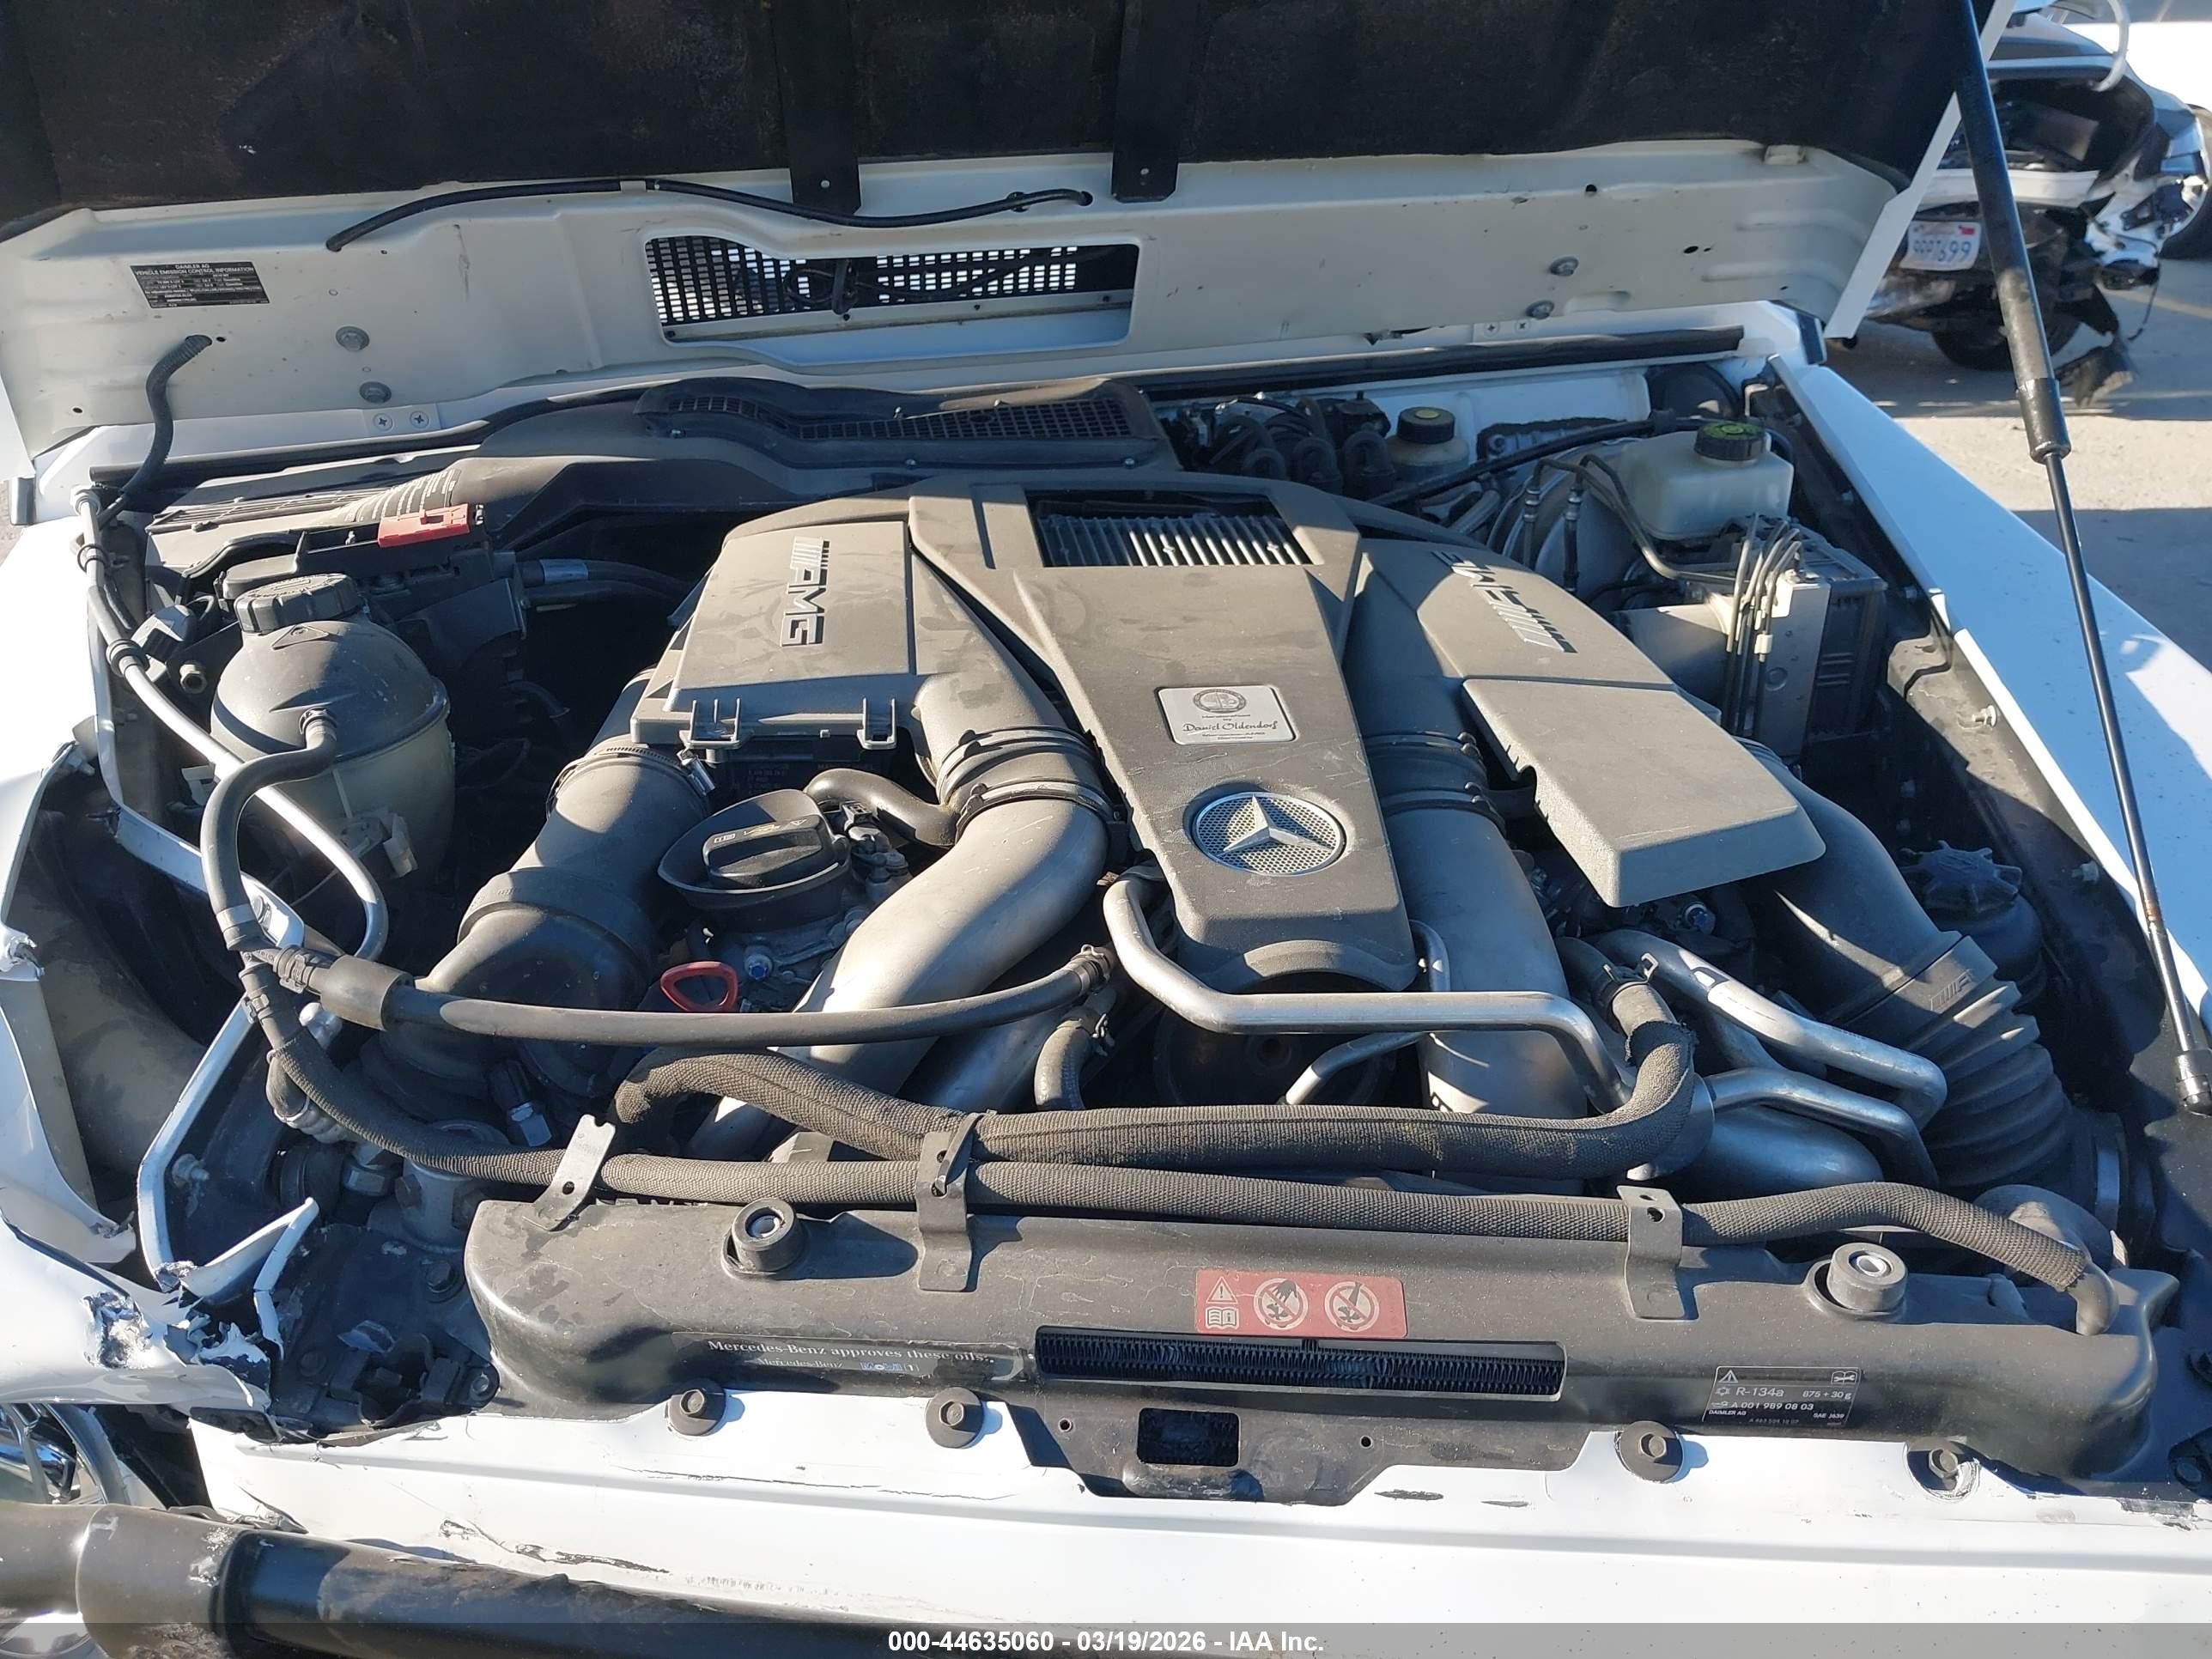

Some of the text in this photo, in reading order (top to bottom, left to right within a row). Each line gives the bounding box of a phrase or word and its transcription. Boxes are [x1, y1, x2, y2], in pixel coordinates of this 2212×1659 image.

[780, 566, 830, 647] AMG
[1182, 720, 1278, 732] Daniel Oldendorf
[708, 1340, 826, 1355] Mercedes-Benz
[830, 1346, 902, 1358] approves
[907, 1349, 951, 1360] these
[1735, 1387, 1785, 1398] R-134a
[1802, 1390, 1821, 1399] 875
[1763, 1401, 1782, 1410] 989
[1800, 1402, 1814, 1411] 03
